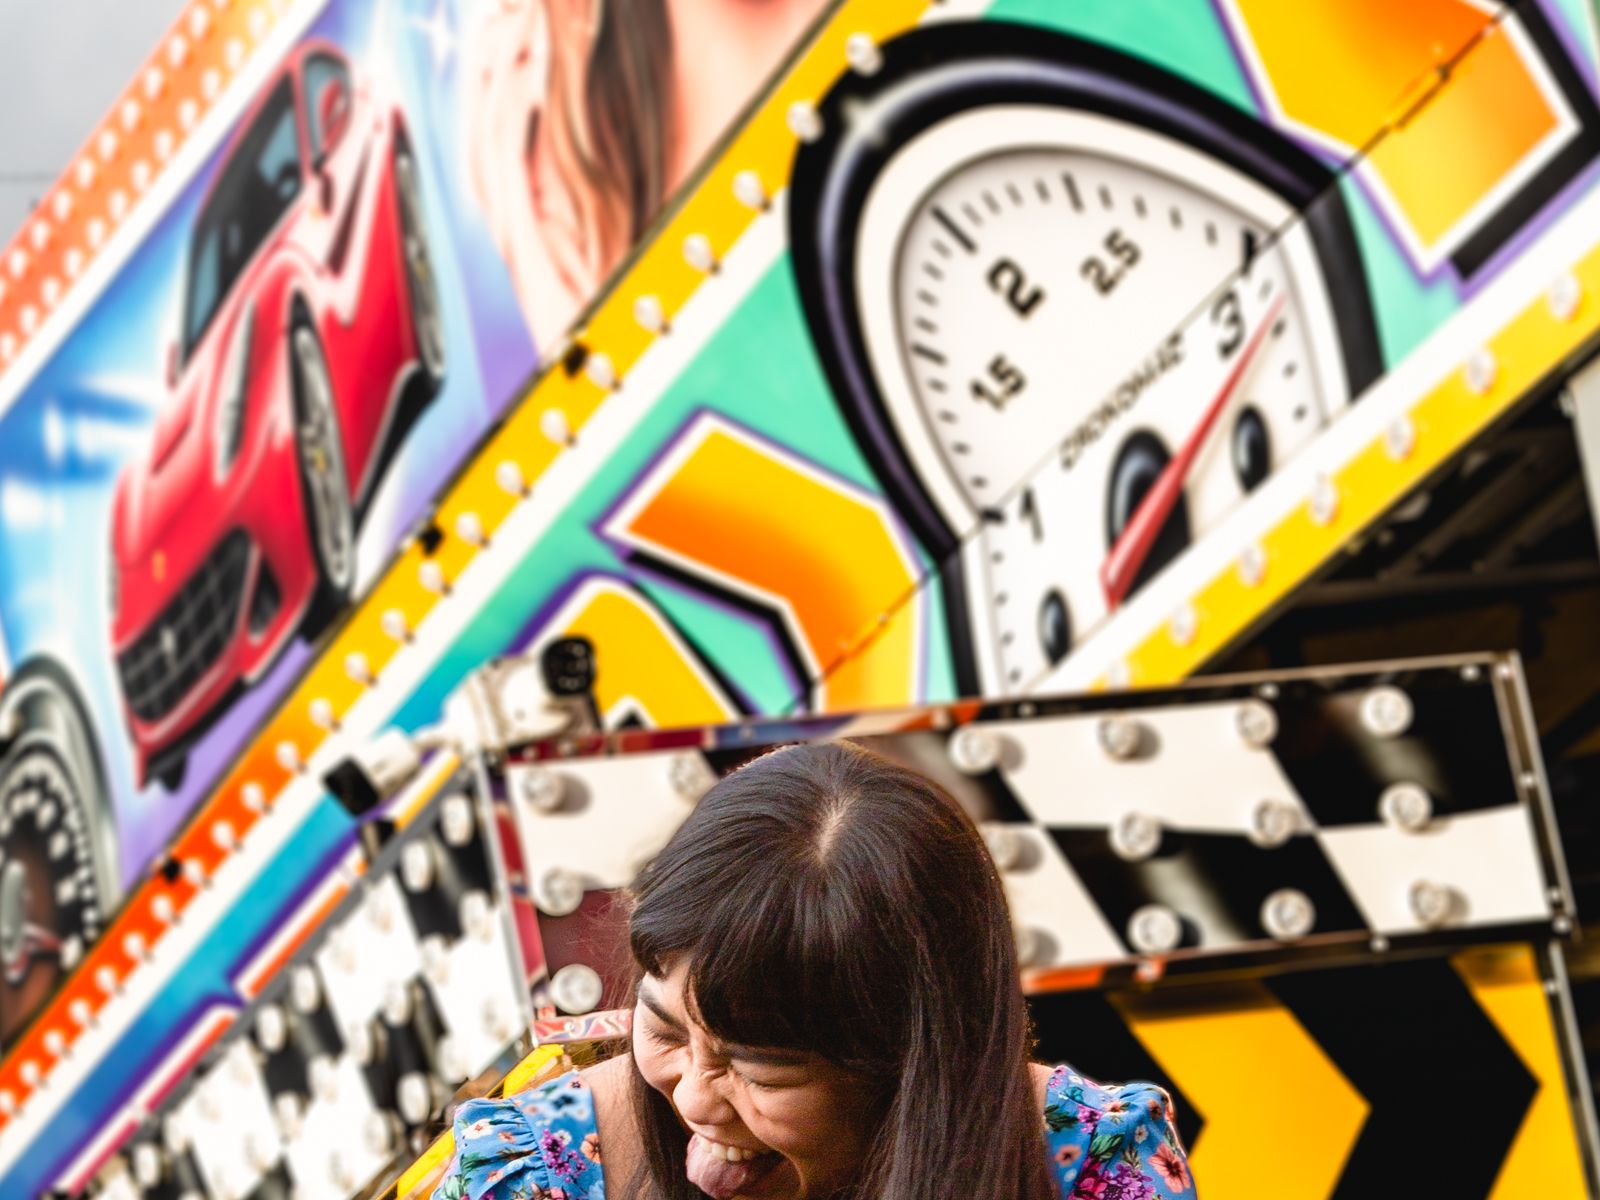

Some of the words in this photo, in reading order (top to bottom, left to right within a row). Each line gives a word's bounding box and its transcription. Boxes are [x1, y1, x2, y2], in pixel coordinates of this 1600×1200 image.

[985, 256, 1046, 320] 2
[1079, 227, 1142, 296] 2.5
[1210, 288, 1246, 361] 3
[1018, 486, 1043, 544] 1
